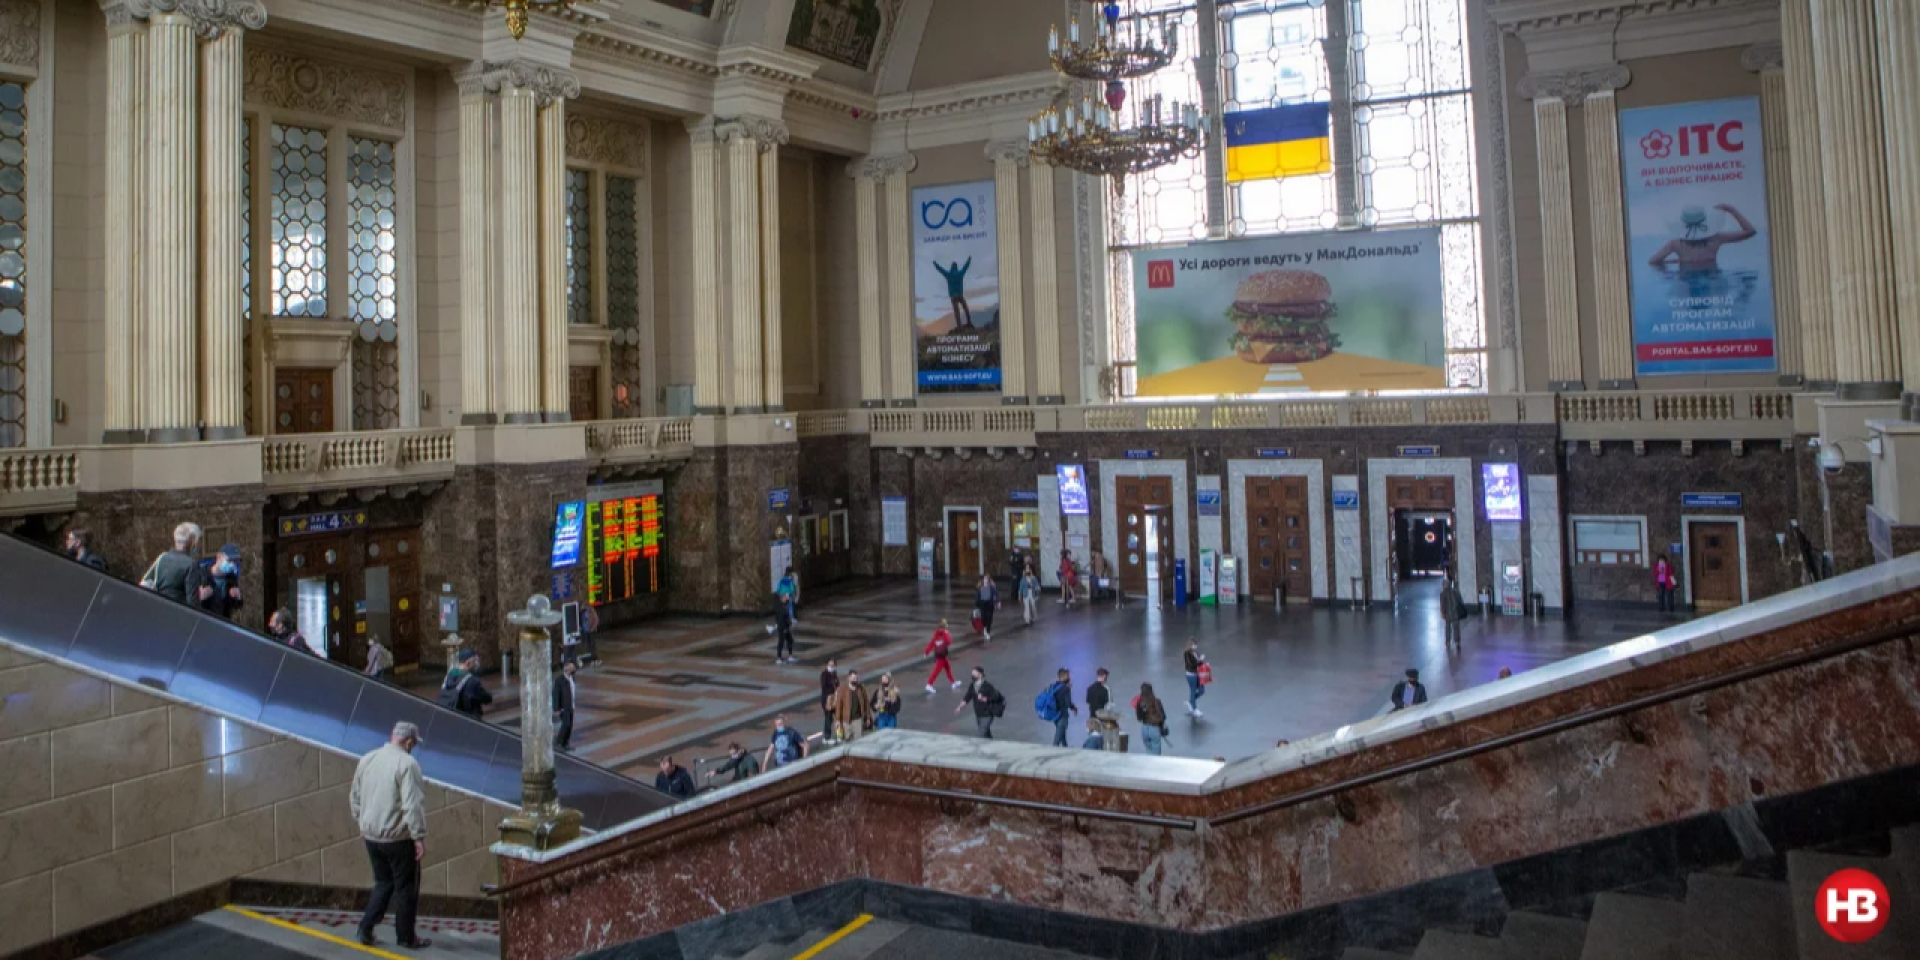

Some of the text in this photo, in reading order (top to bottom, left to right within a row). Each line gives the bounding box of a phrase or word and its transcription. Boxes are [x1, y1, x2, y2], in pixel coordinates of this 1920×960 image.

[1678, 120, 1744, 156] ITC
[1641, 168, 1655, 177] ВИ
[1655, 176, 1693, 187] БІЗНЕС
[1695, 171, 1744, 183] ПРАЦЮЄ
[1178, 258, 1198, 271] Усі
[1201, 256, 1250, 271] дороги
[1253, 252, 1301, 266] ведуть
[1304, 252, 1313, 265] у
[1669, 295, 1734, 308] СУПРОВІД
[1671, 308, 1732, 319] ПРОГРАМ
[1651, 318, 1756, 333] АВТОМАТИЗАЦІЇ
[1652, 344, 1758, 356] PORTAL.BAS-SOFT.EU
[329, 514, 340, 528] 4
